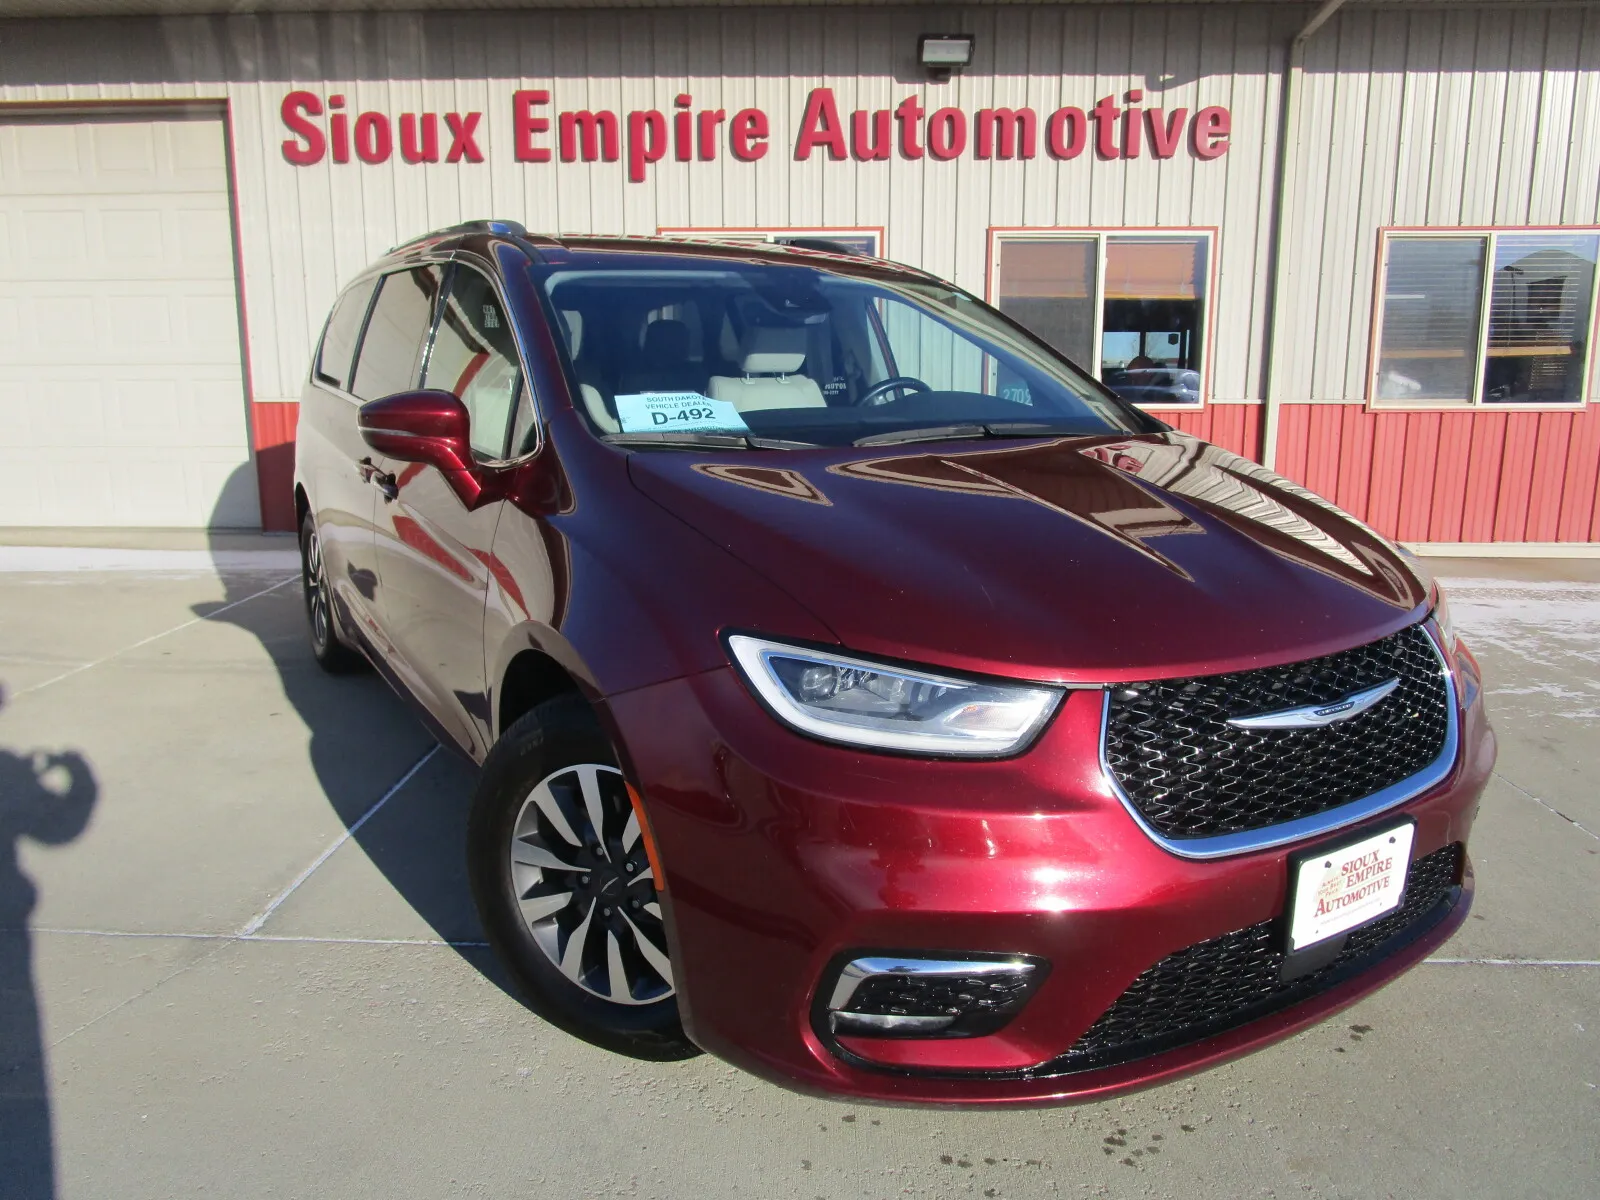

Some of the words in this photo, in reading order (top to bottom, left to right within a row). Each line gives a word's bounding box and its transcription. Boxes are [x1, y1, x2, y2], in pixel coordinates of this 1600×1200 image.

[280, 90, 485, 166] Sioux
[512, 89, 769, 183] Empire
[793, 87, 1232, 161] Automotive
[644, 402, 680, 410] VEHICLE
[681, 400, 713, 408] DEALER
[674, 394, 706, 402] DAKOTA
[651, 407, 717, 426] D-492
[1341, 848, 1380, 876] SIOUX
[1345, 857, 1393, 888] EMPIRE
[1313, 875, 1391, 918] AUTOMOTIVE
